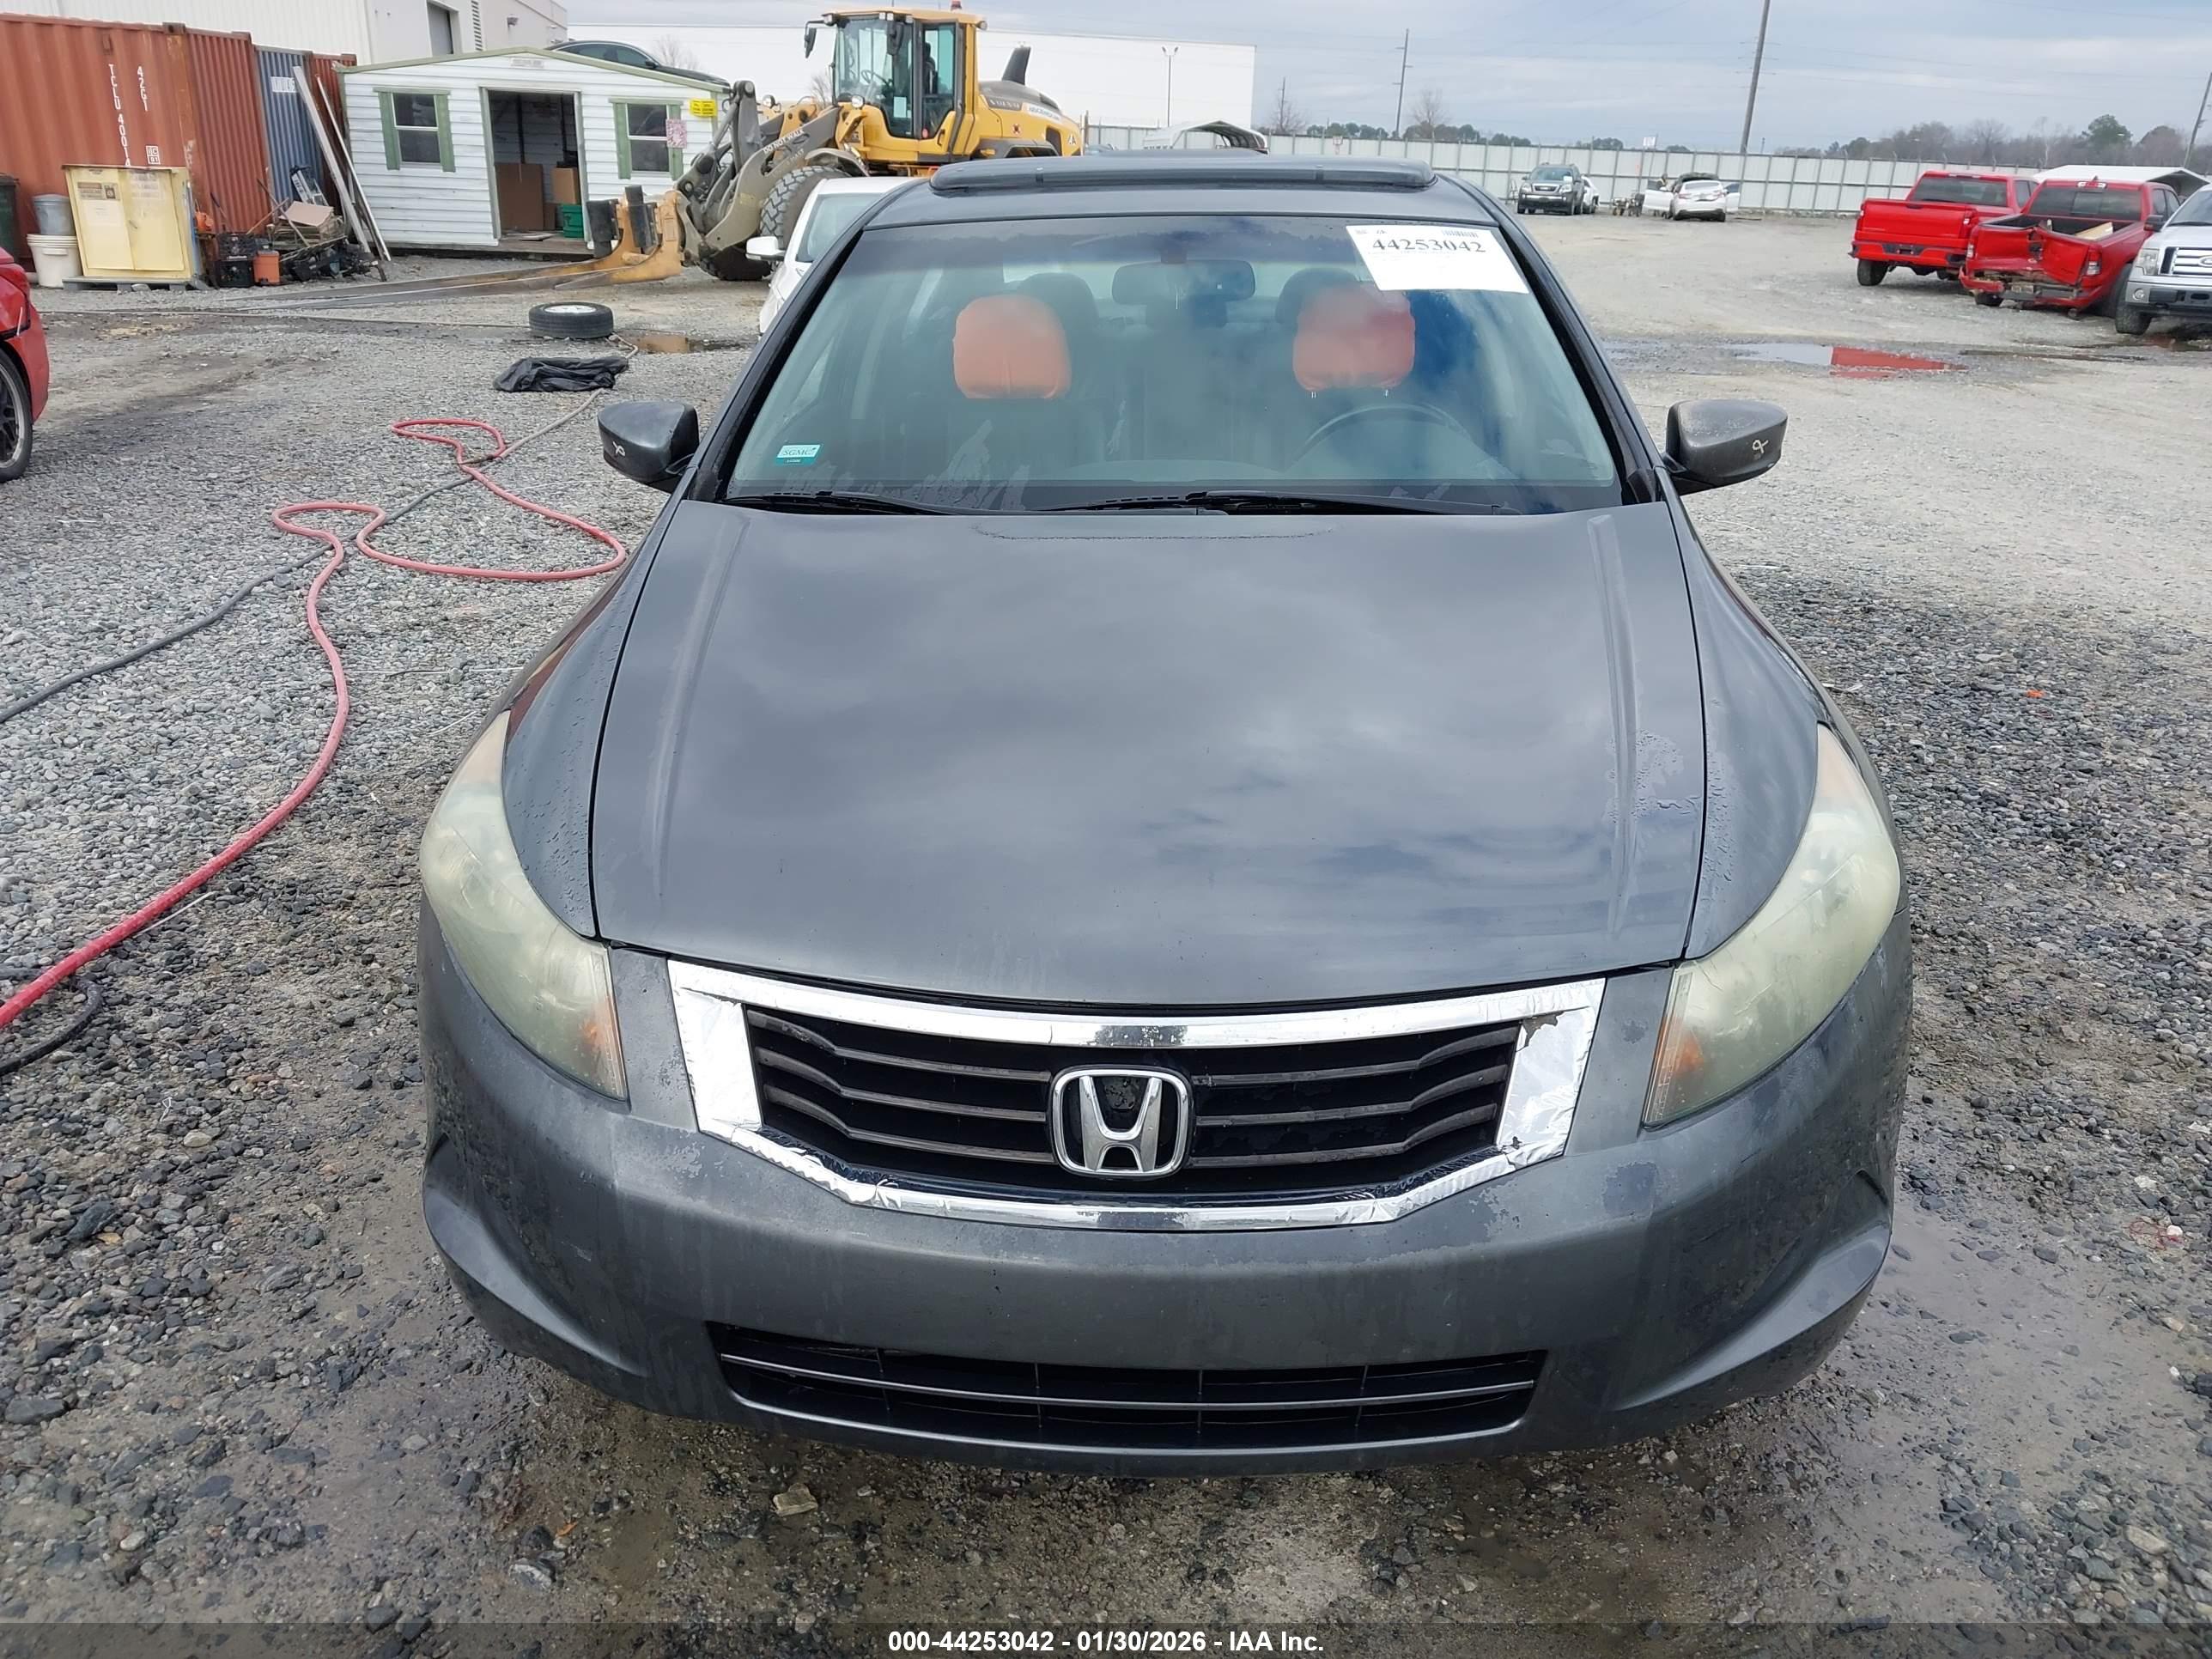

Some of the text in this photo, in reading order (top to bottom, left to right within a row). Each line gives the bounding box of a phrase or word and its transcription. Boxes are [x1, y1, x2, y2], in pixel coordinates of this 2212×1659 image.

[108, 64, 121, 110] TCLU
[137, 65, 149, 112] 42G1
[1372, 239, 1486, 253] 44253042
